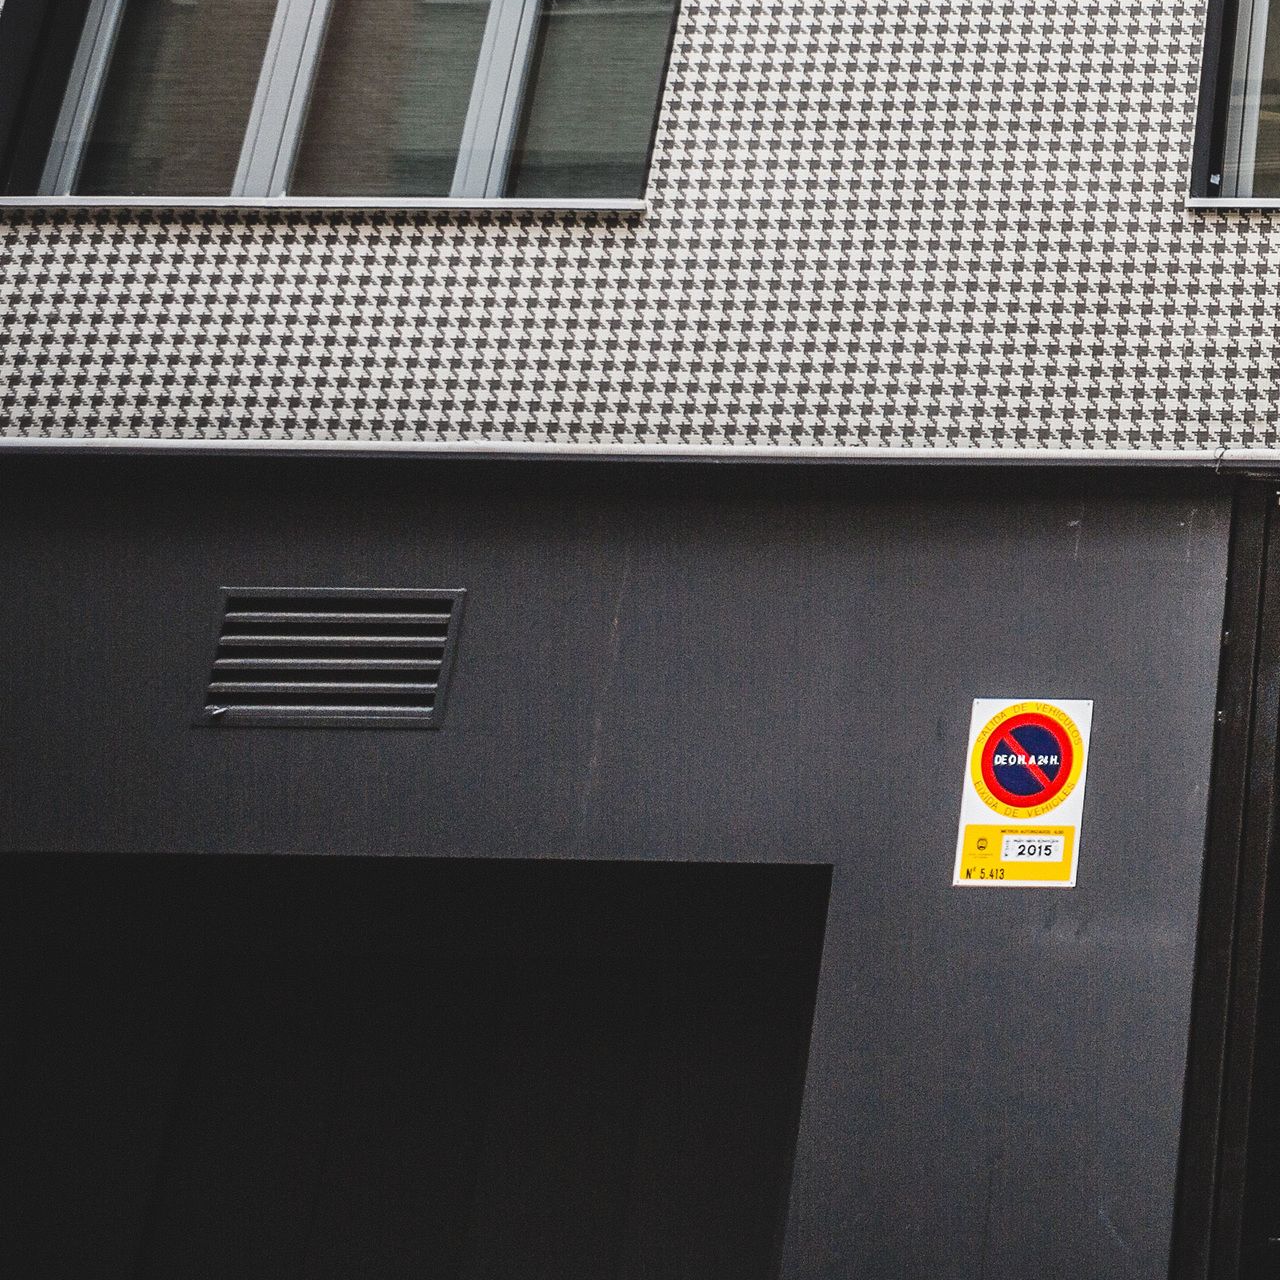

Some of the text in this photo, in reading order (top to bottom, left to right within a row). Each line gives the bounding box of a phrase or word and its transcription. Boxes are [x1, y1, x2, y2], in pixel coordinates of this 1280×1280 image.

[977, 703, 1083, 746] SALIDA DE VEHICULOS
[994, 755, 1007, 766] DE
[1028, 755, 1036, 766] A
[1037, 755, 1048, 766] 24
[973, 780, 1075, 818] EIXIDA DE VEHICLES
[1017, 844, 1053, 857] 2015
[979, 867, 1006, 880] 5.413
